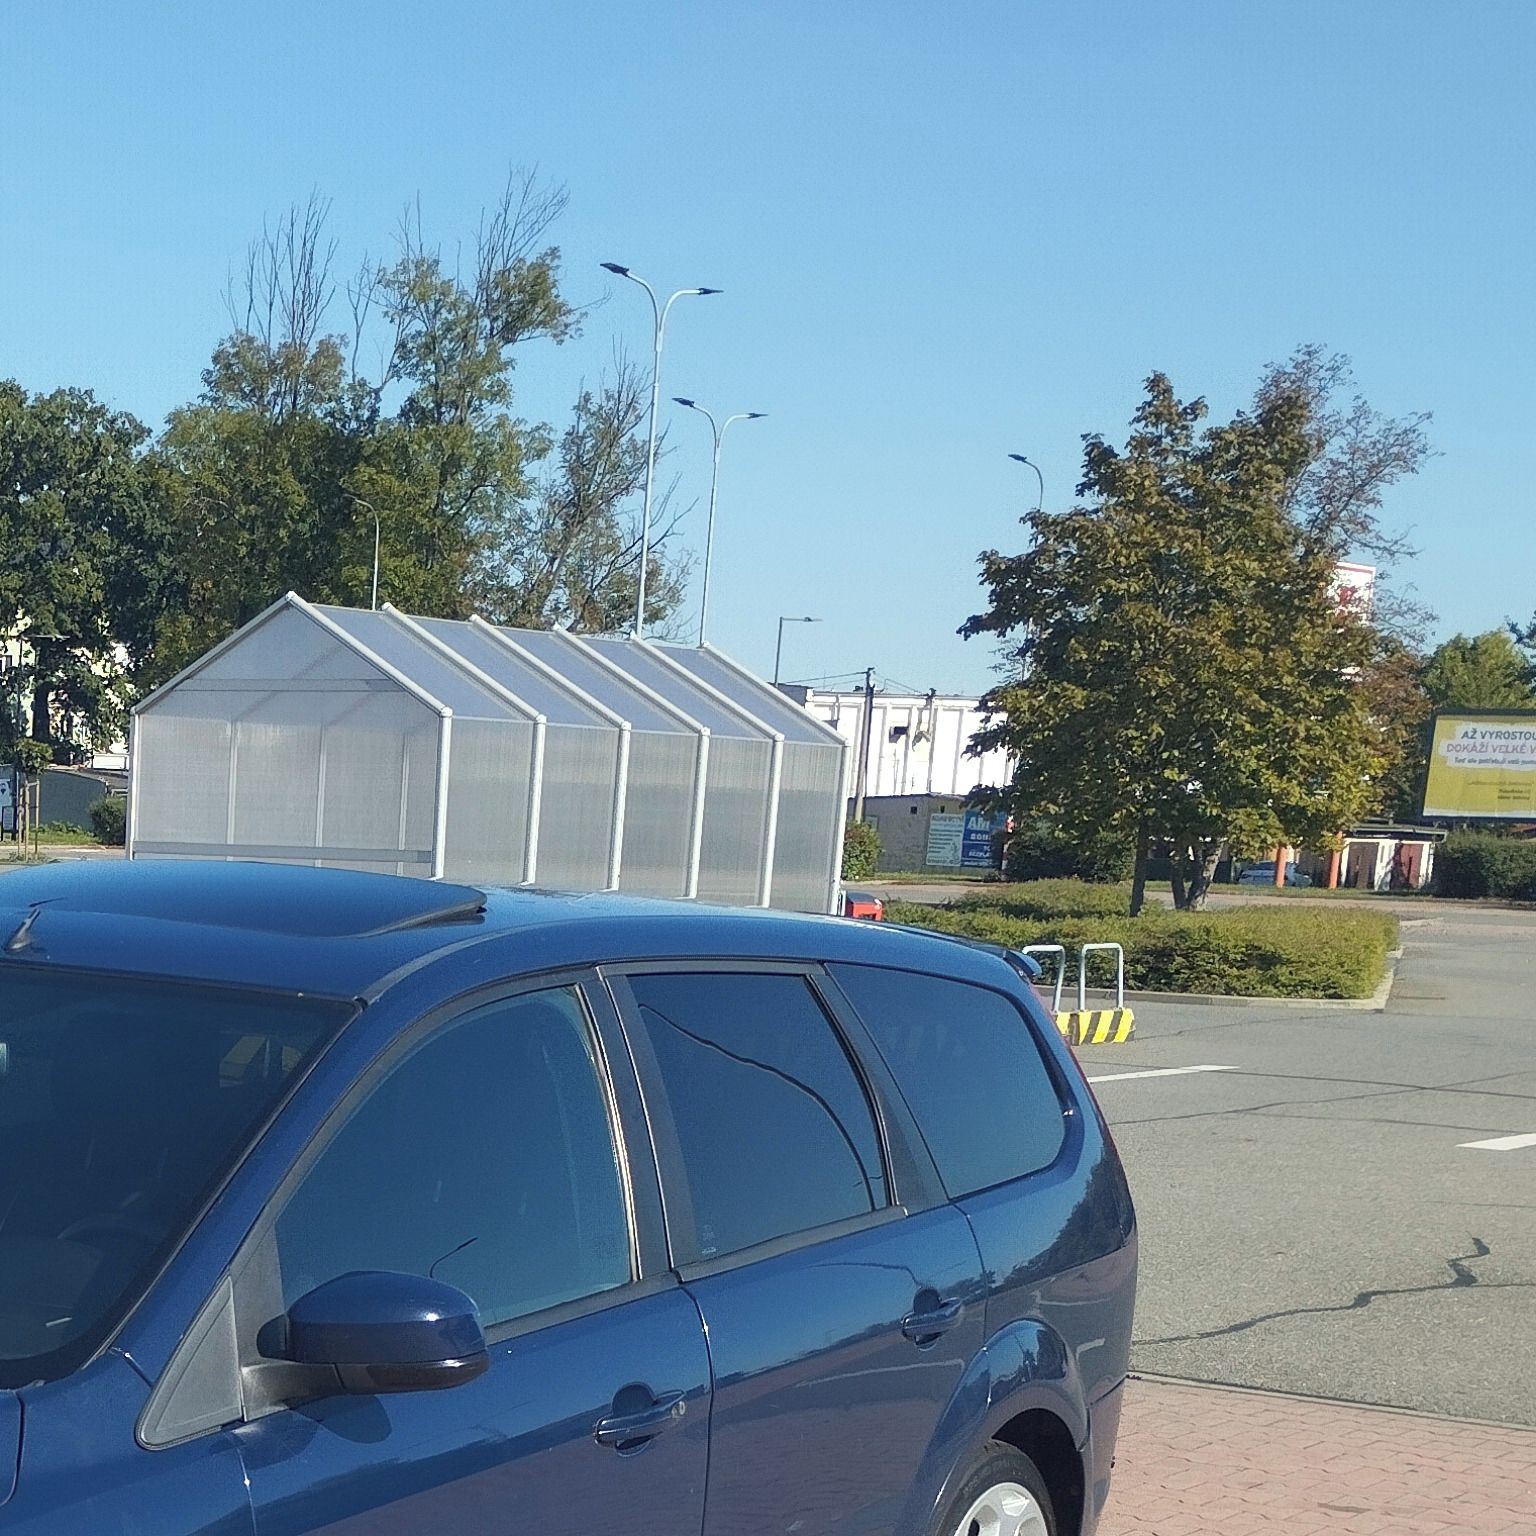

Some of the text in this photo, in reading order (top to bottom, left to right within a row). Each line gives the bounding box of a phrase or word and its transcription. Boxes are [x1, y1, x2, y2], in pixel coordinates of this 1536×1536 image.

[1460, 728, 1477, 739] AŽ
[1446, 741, 1489, 754] DOKÁŽÍ
[1492, 743, 1526, 755] VELKÉ
